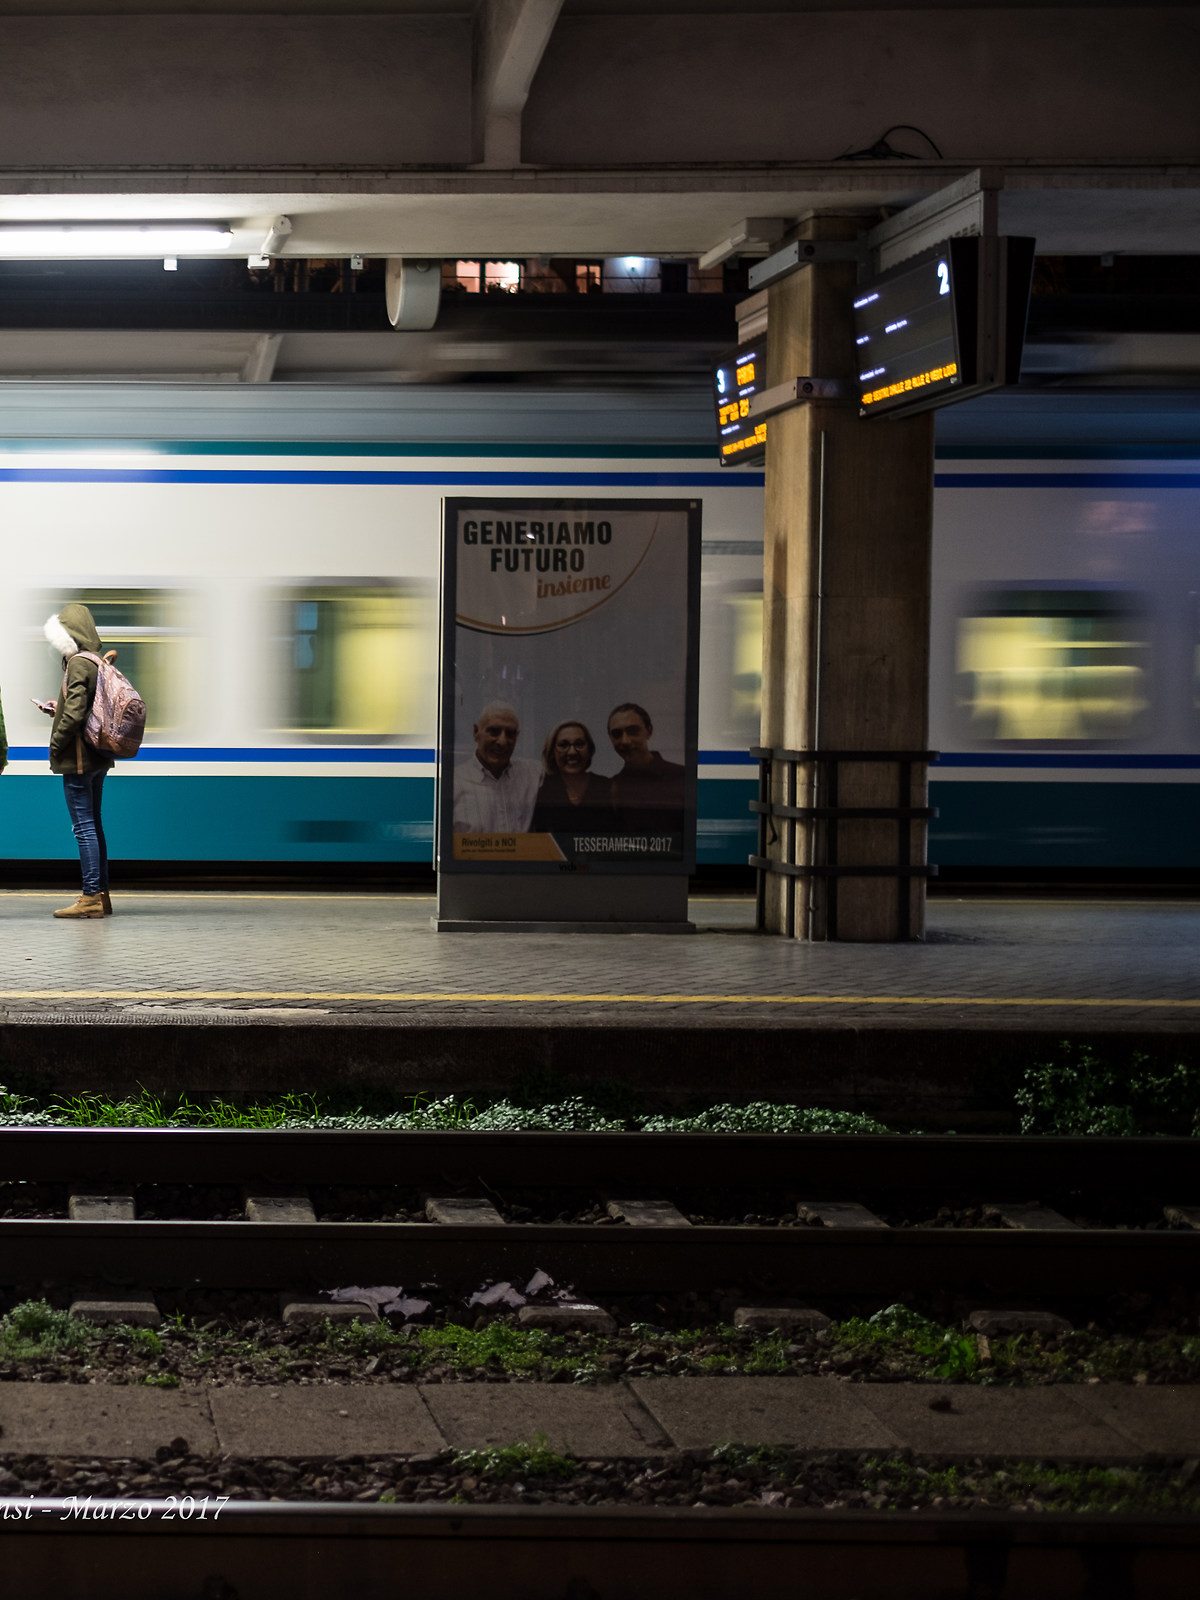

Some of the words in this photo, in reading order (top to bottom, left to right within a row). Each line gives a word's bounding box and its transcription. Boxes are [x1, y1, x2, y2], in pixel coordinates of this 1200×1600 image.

[937, 261, 950, 295] 2
[716, 368, 726, 394] 3
[463, 521, 612, 545] GENERIAMO
[491, 548, 585, 572] FUTURO
[537, 575, 611, 598] insieme
[461, 837, 493, 848] Rivolgiti
[501, 837, 517, 847] NOI
[573, 837, 648, 852] TESSERAMENTO
[649, 837, 673, 852] 2017
